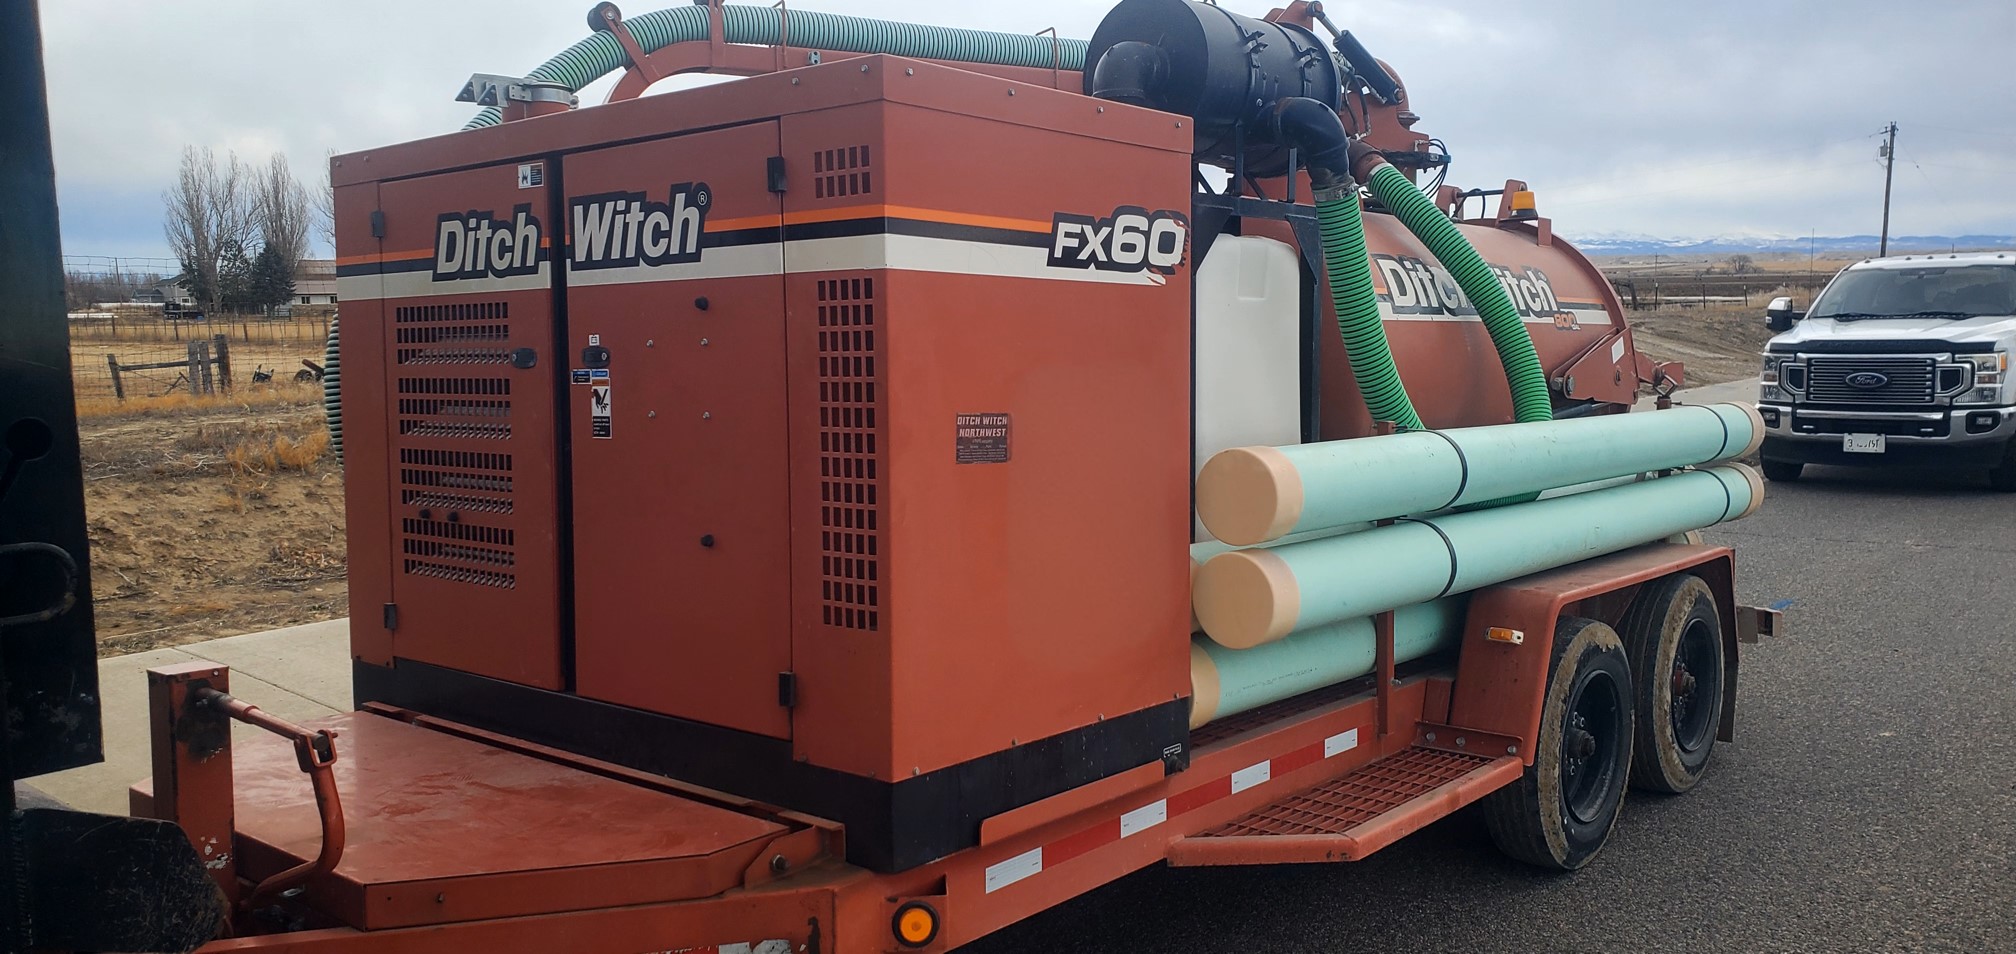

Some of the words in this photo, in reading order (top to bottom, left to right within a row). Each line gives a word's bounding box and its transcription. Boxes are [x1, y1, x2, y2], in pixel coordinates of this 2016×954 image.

[436, 212, 538, 274] Ditch
[1053, 213, 1186, 267] FX60
[1492, 267, 1559, 312] itch
[957, 416, 981, 425] DITCH
[982, 416, 1008, 425] WITCH
[959, 428, 1007, 437] NORTHWEST
